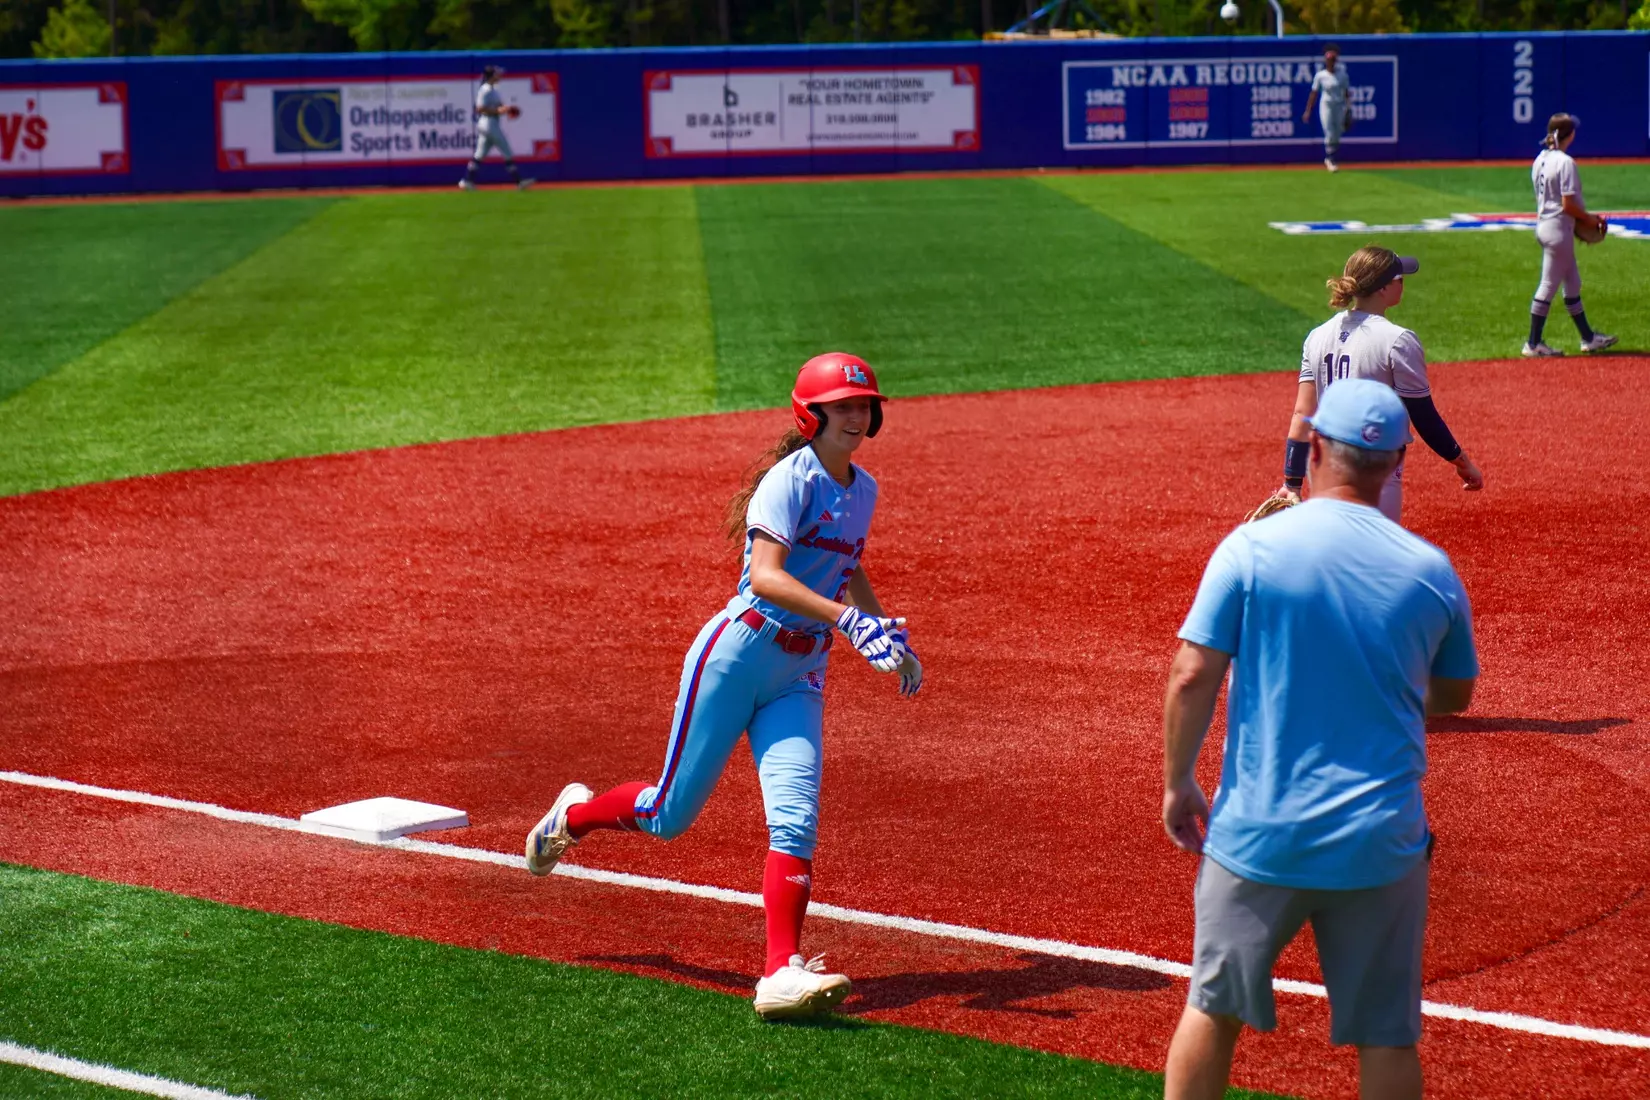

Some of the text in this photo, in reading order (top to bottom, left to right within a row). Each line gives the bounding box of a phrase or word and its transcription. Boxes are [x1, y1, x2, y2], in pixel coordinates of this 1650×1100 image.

[1112, 63, 1347, 87] NCAA REGIONA
[1513, 40, 1533, 124] 220
[788, 93, 822, 106] REAL
[824, 92, 872, 105] ESTATE
[350, 103, 466, 130] Orthopaedic
[685, 111, 776, 128] BRASHER
[350, 128, 477, 157] Sports Medic
[1323, 352, 1351, 387] 10
